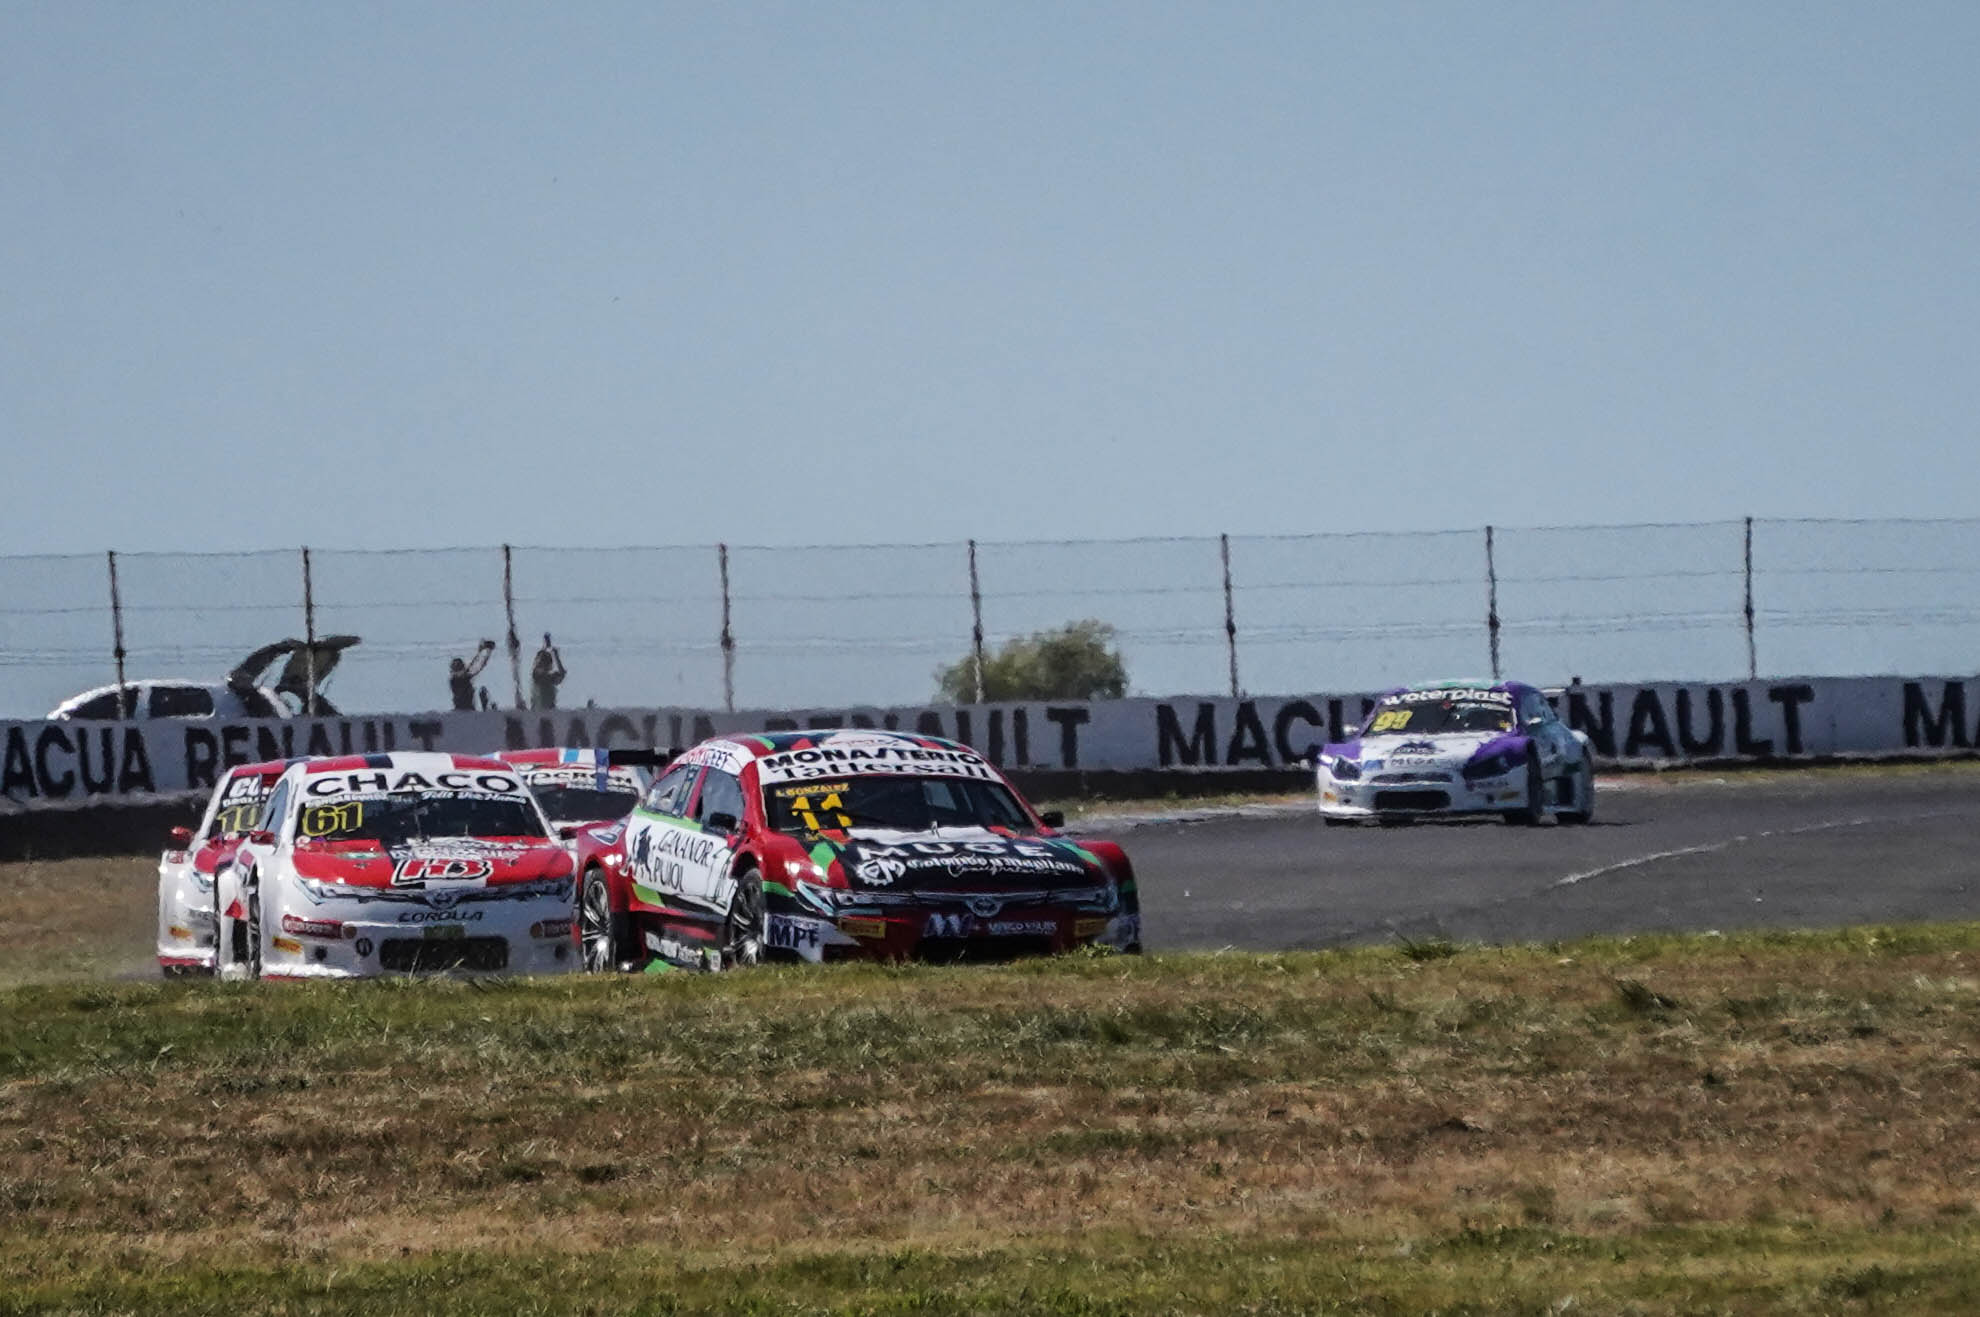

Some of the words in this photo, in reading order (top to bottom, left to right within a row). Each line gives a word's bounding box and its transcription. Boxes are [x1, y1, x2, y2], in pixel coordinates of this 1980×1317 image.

[1385, 688, 1514, 705] waterplast
[1157, 699, 1366, 767] MACU
[1567, 685, 1814, 756] NAULT
[1373, 711, 1413, 732] 99
[3, 725, 155, 797] ACUA
[764, 747, 983, 770] MONASTERIO
[773, 762, 990, 779] Tattersall
[307, 773, 519, 797] CHACO
[303, 801, 363, 836] 61
[792, 794, 852, 830] 11
[399, 910, 484, 922] COROLLA
